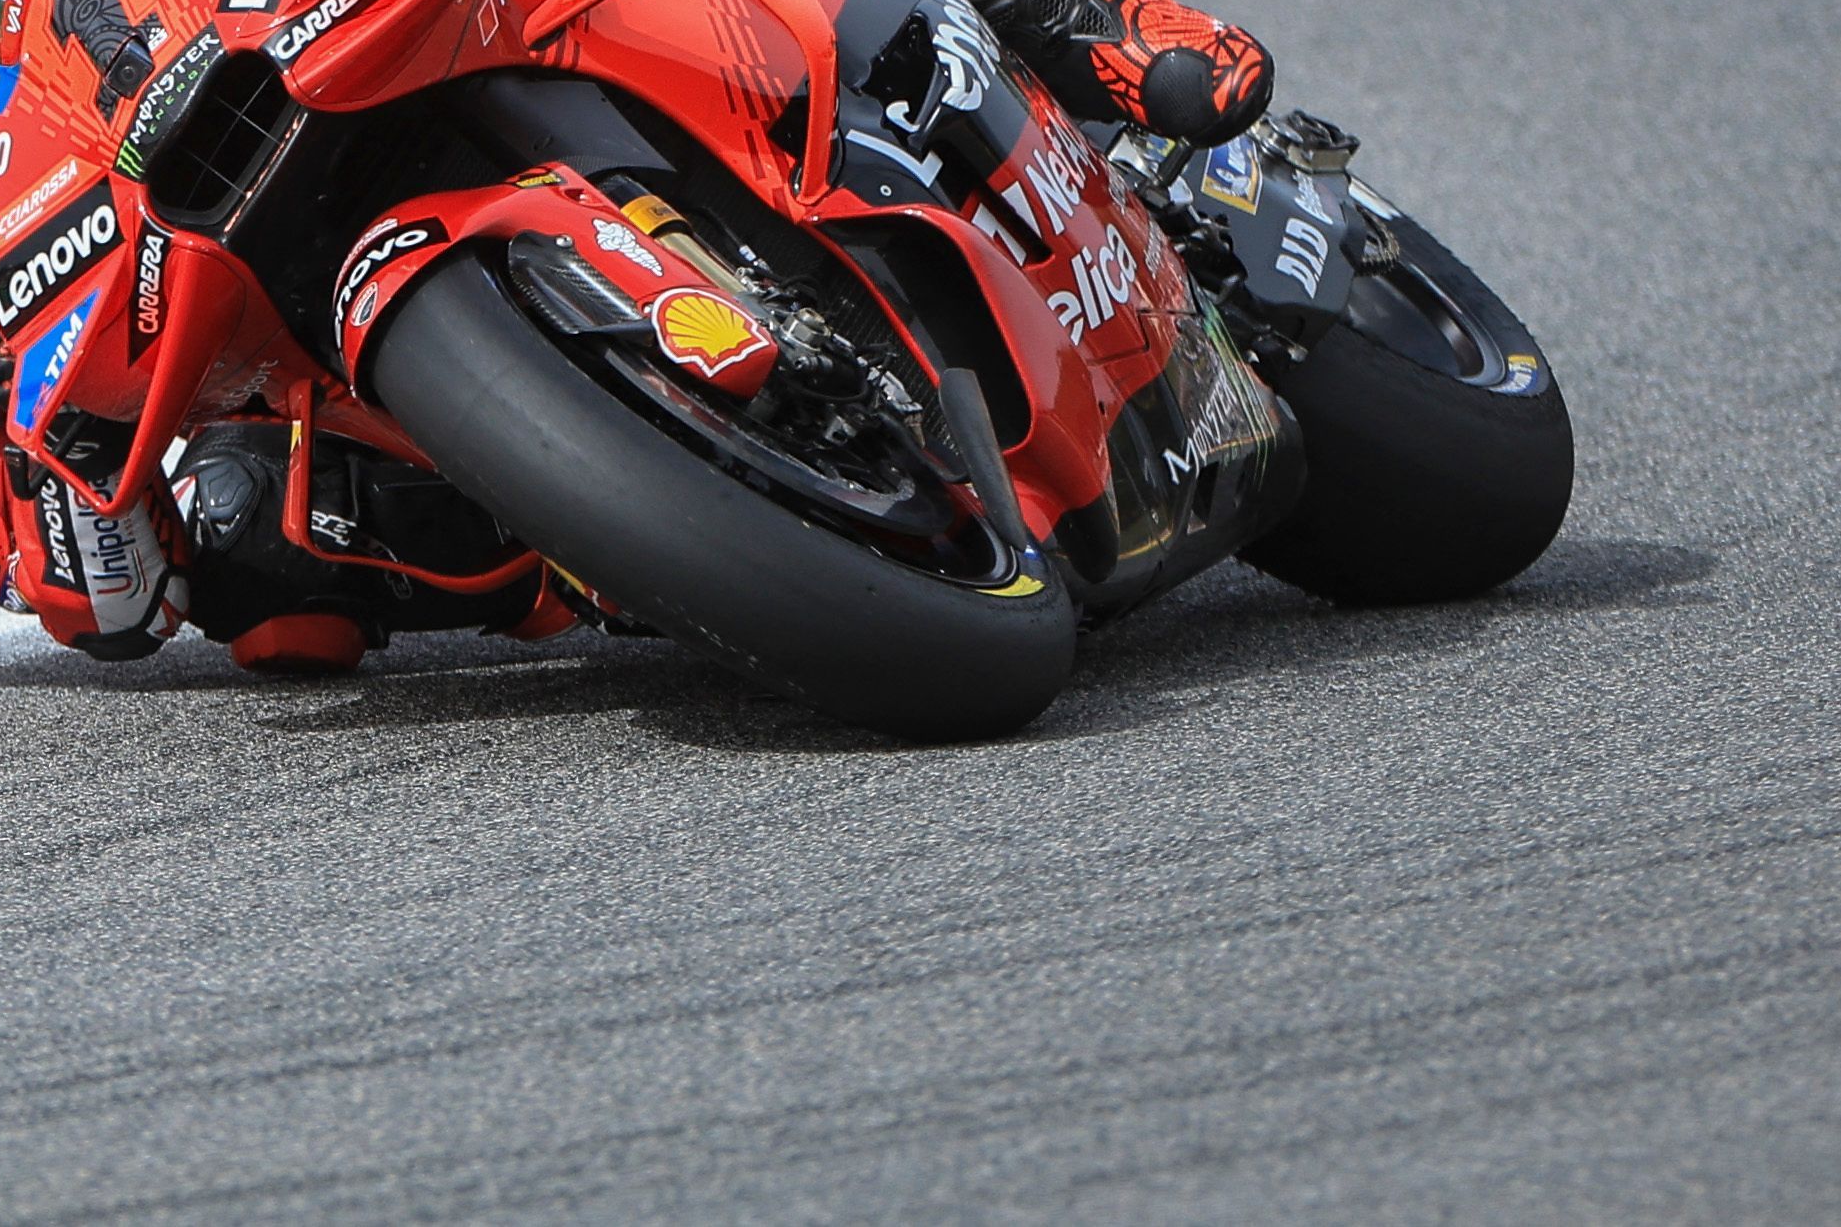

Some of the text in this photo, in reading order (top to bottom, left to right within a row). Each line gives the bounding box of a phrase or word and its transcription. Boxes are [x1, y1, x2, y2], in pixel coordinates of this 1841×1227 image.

[130, 33, 220, 145] MONSTER
[148, 59, 209, 135] ENERGY
[138, 234, 164, 334] CARRERA
[1047, 223, 1137, 346] elica
[44, 313, 83, 380] TIM
